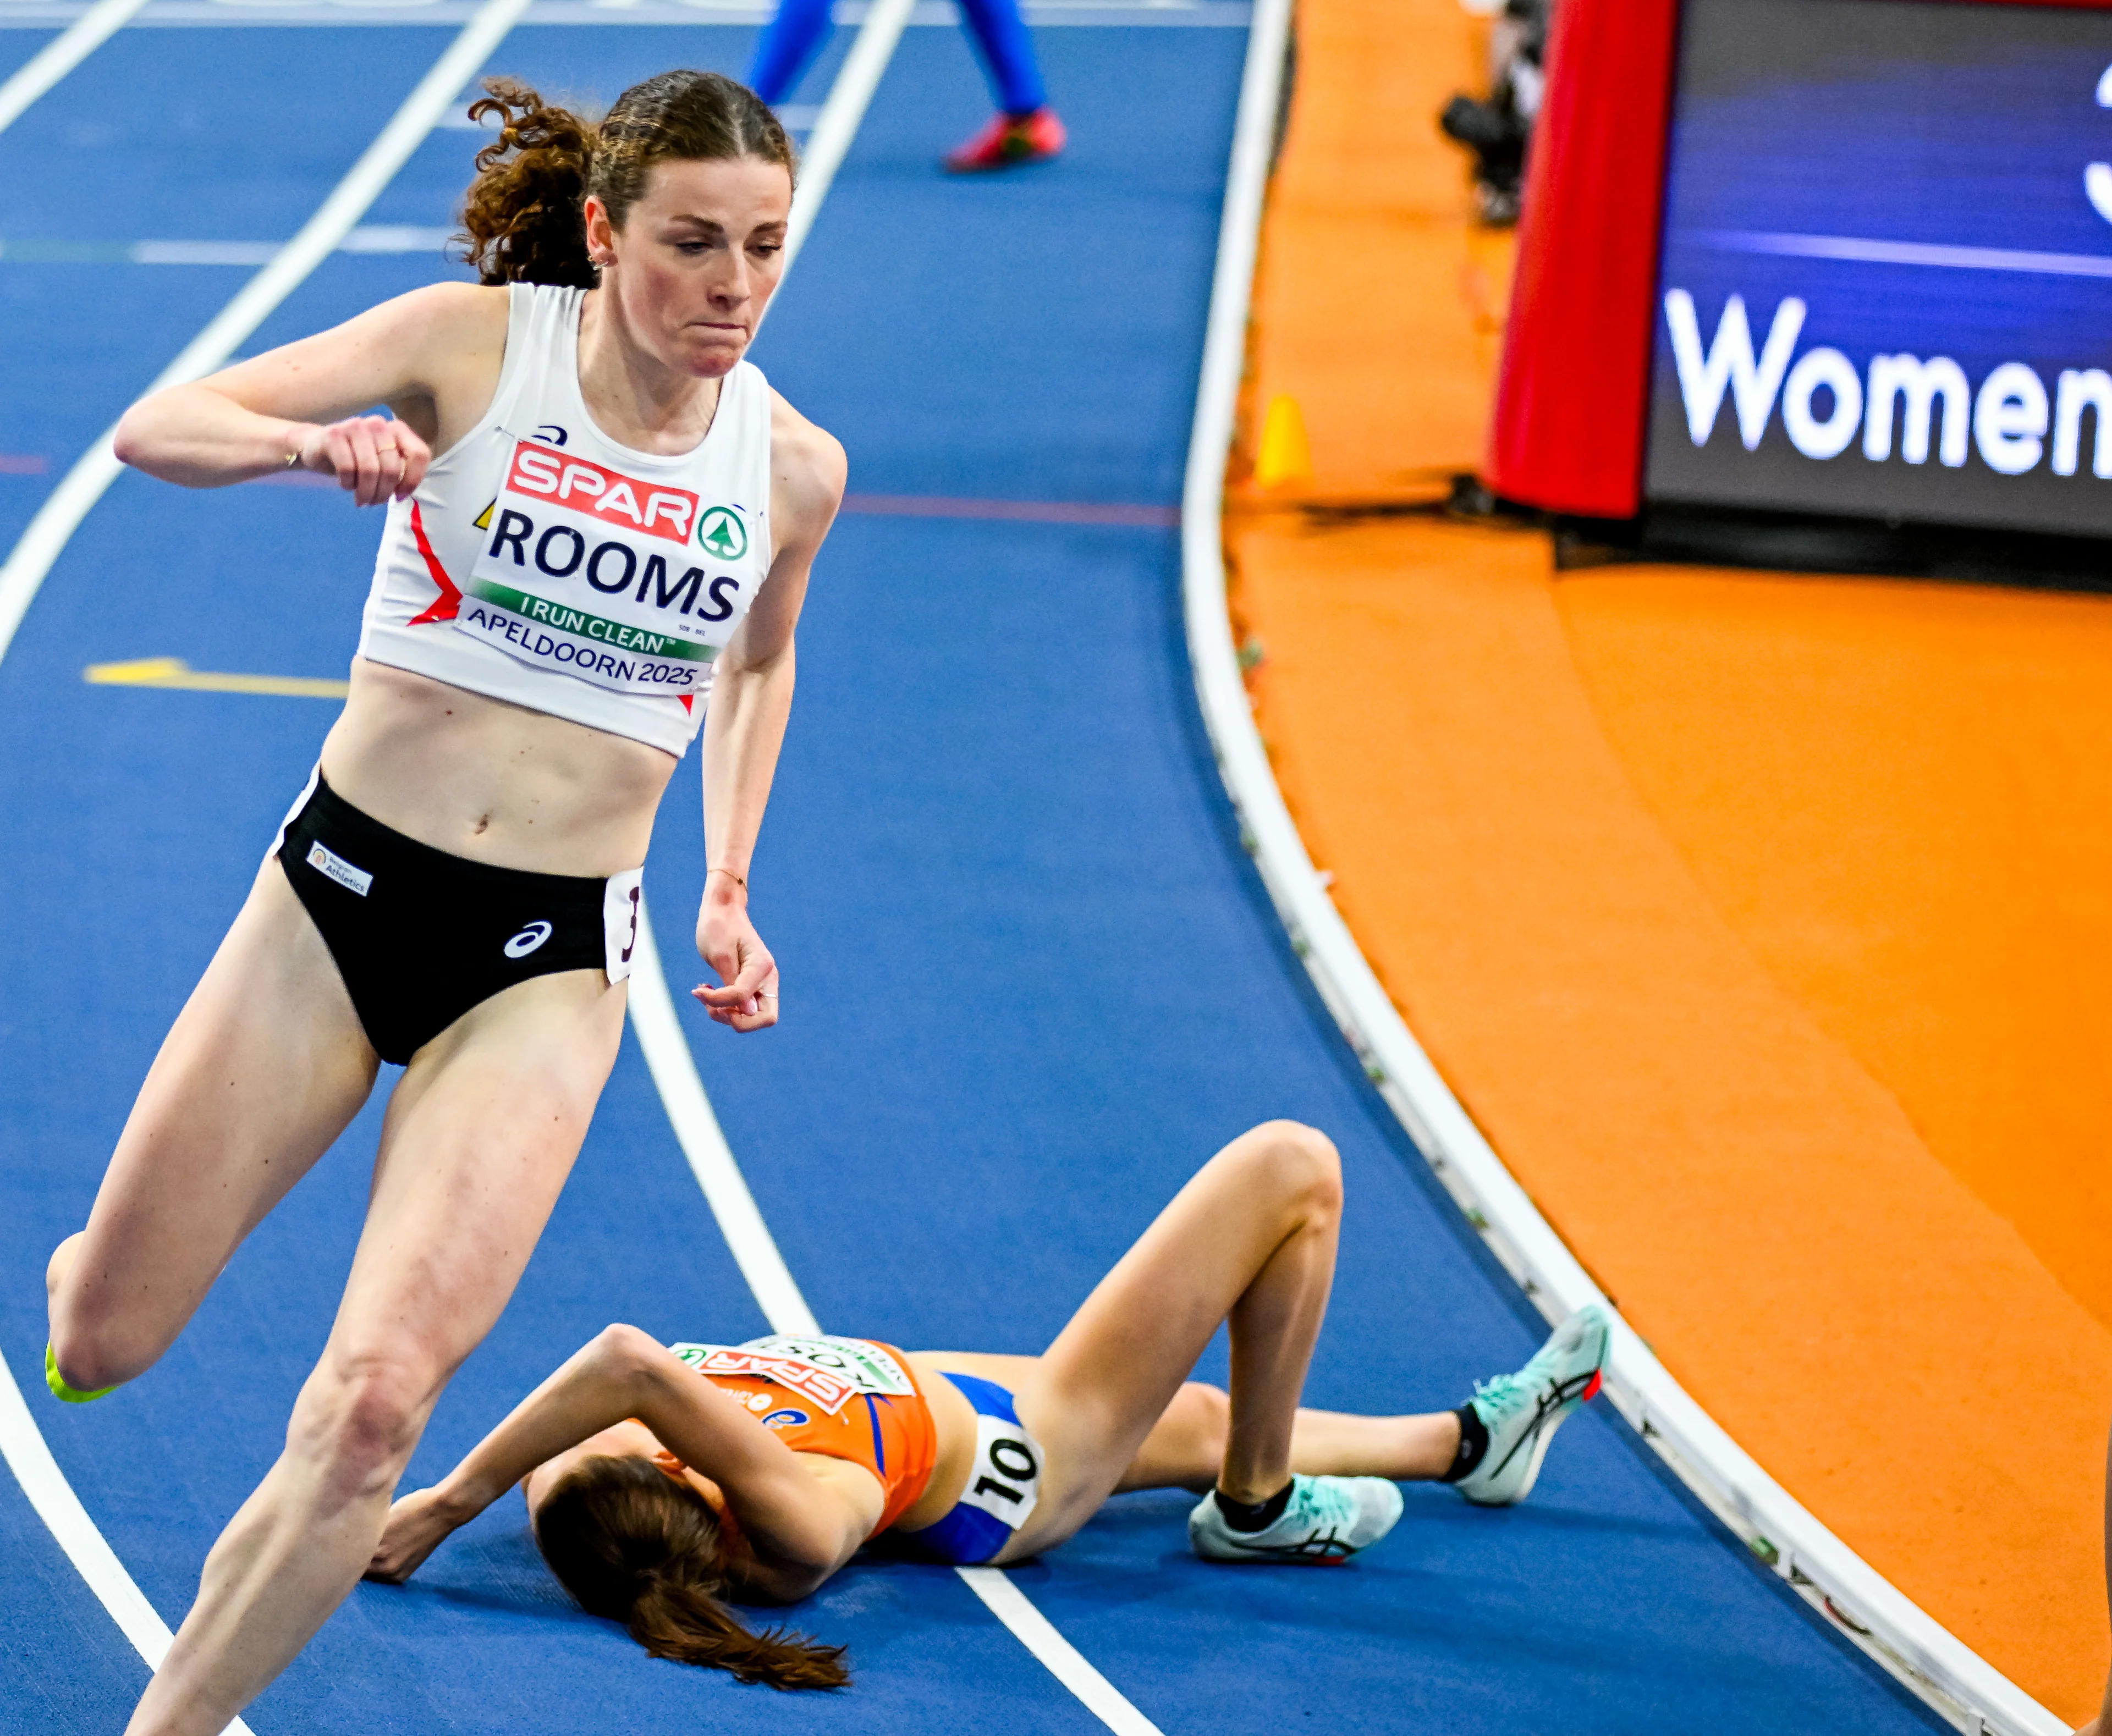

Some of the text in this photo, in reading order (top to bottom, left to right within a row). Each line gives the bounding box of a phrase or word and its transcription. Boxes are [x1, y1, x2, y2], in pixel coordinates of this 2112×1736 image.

[512, 449, 694, 536] SPAR
[488, 508, 740, 623] ROOMS
[468, 608, 697, 686] APELDOORN 2025
[520, 597, 529, 611] I
[531, 599, 584, 632] RUN
[326, 864, 365, 892] Athletics
[707, 1352, 848, 1402] SPAR
[975, 1439, 1037, 1505] 10
